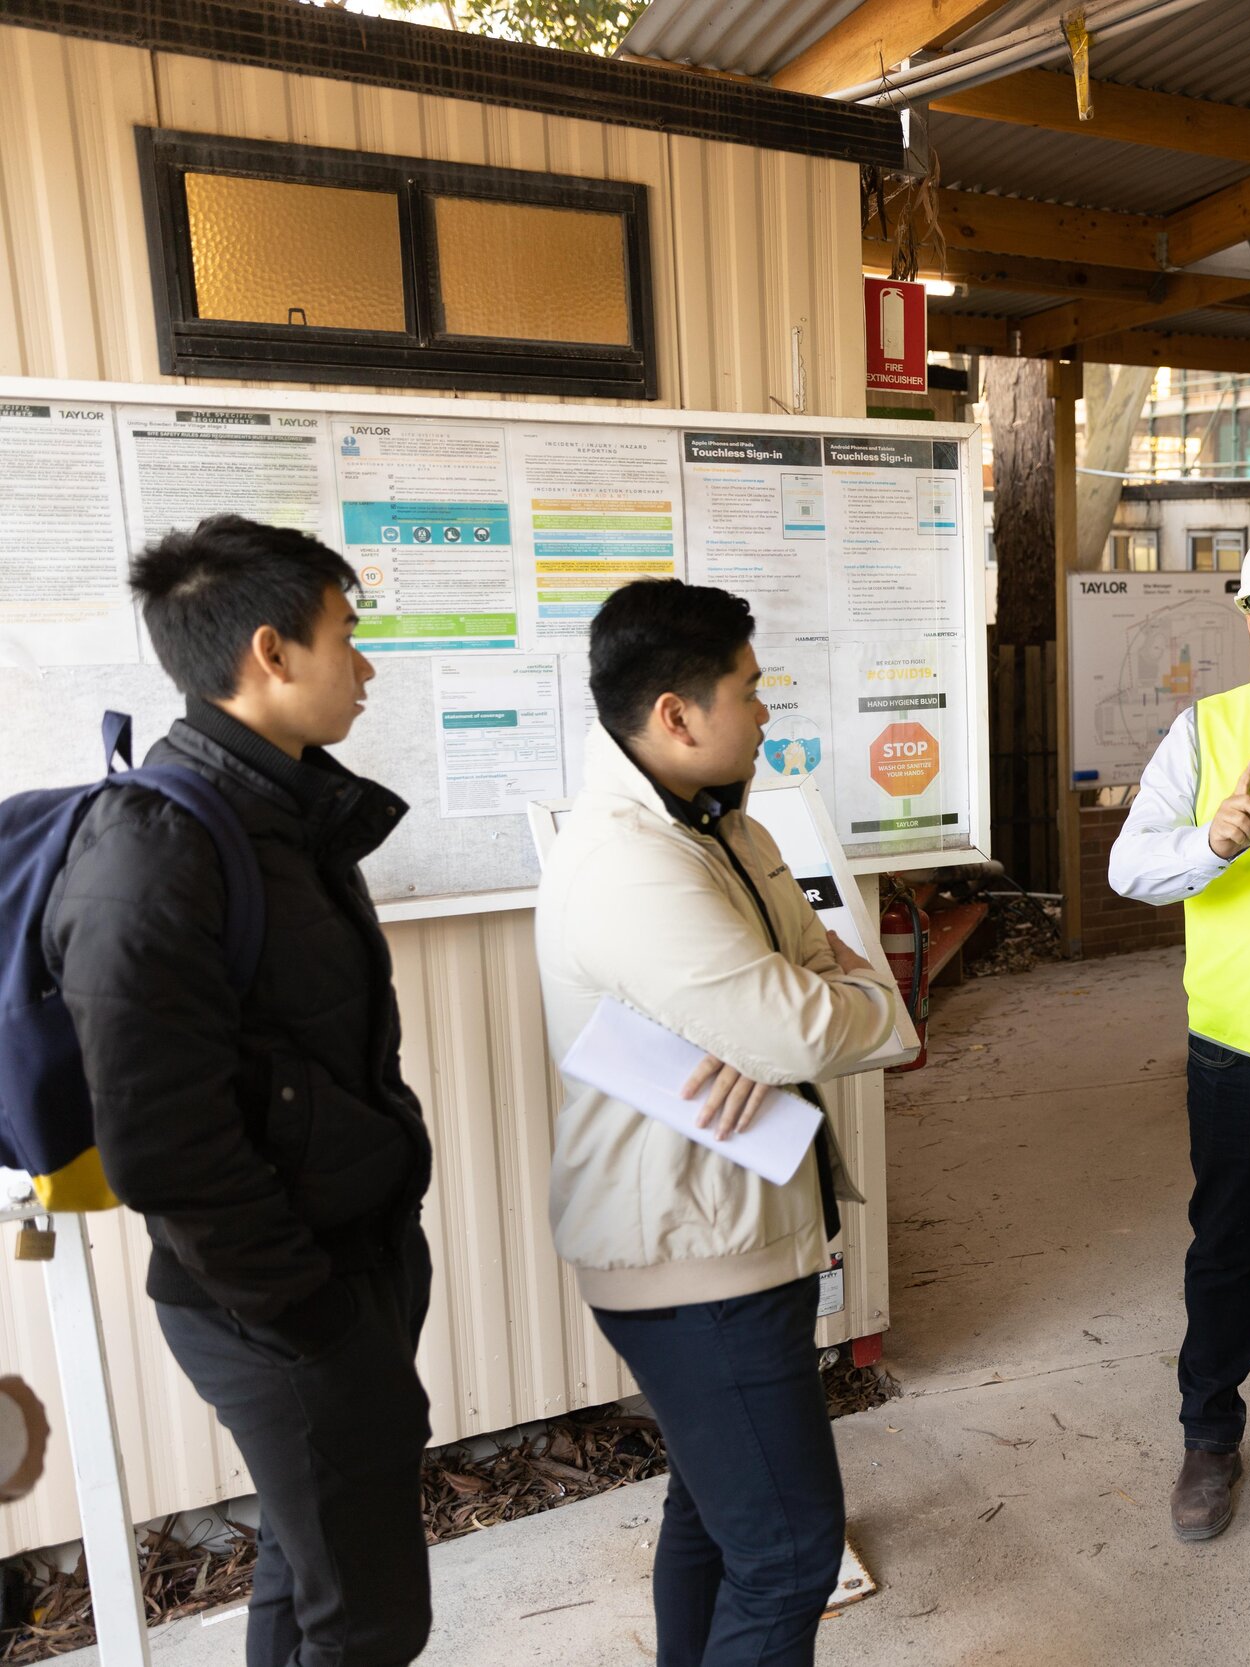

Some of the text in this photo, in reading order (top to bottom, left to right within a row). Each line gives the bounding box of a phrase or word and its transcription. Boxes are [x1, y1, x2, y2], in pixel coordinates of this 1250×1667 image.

[885, 363, 904, 373] FIRE
[866, 373, 923, 385] EXTINGUISHER
[59, 411, 104, 420] TAYLOR
[278, 418, 318, 428] TAYLOR
[350, 426, 390, 435] TAYLOR
[692, 448, 783, 460] Touchless Sign-in
[831, 452, 913, 463] Touchless Sign-in
[1080, 581, 1127, 594] TAYLOR
[770, 702, 798, 710] HANDS
[889, 699, 919, 707] HYGIENE
[883, 741, 928, 758] STOP
